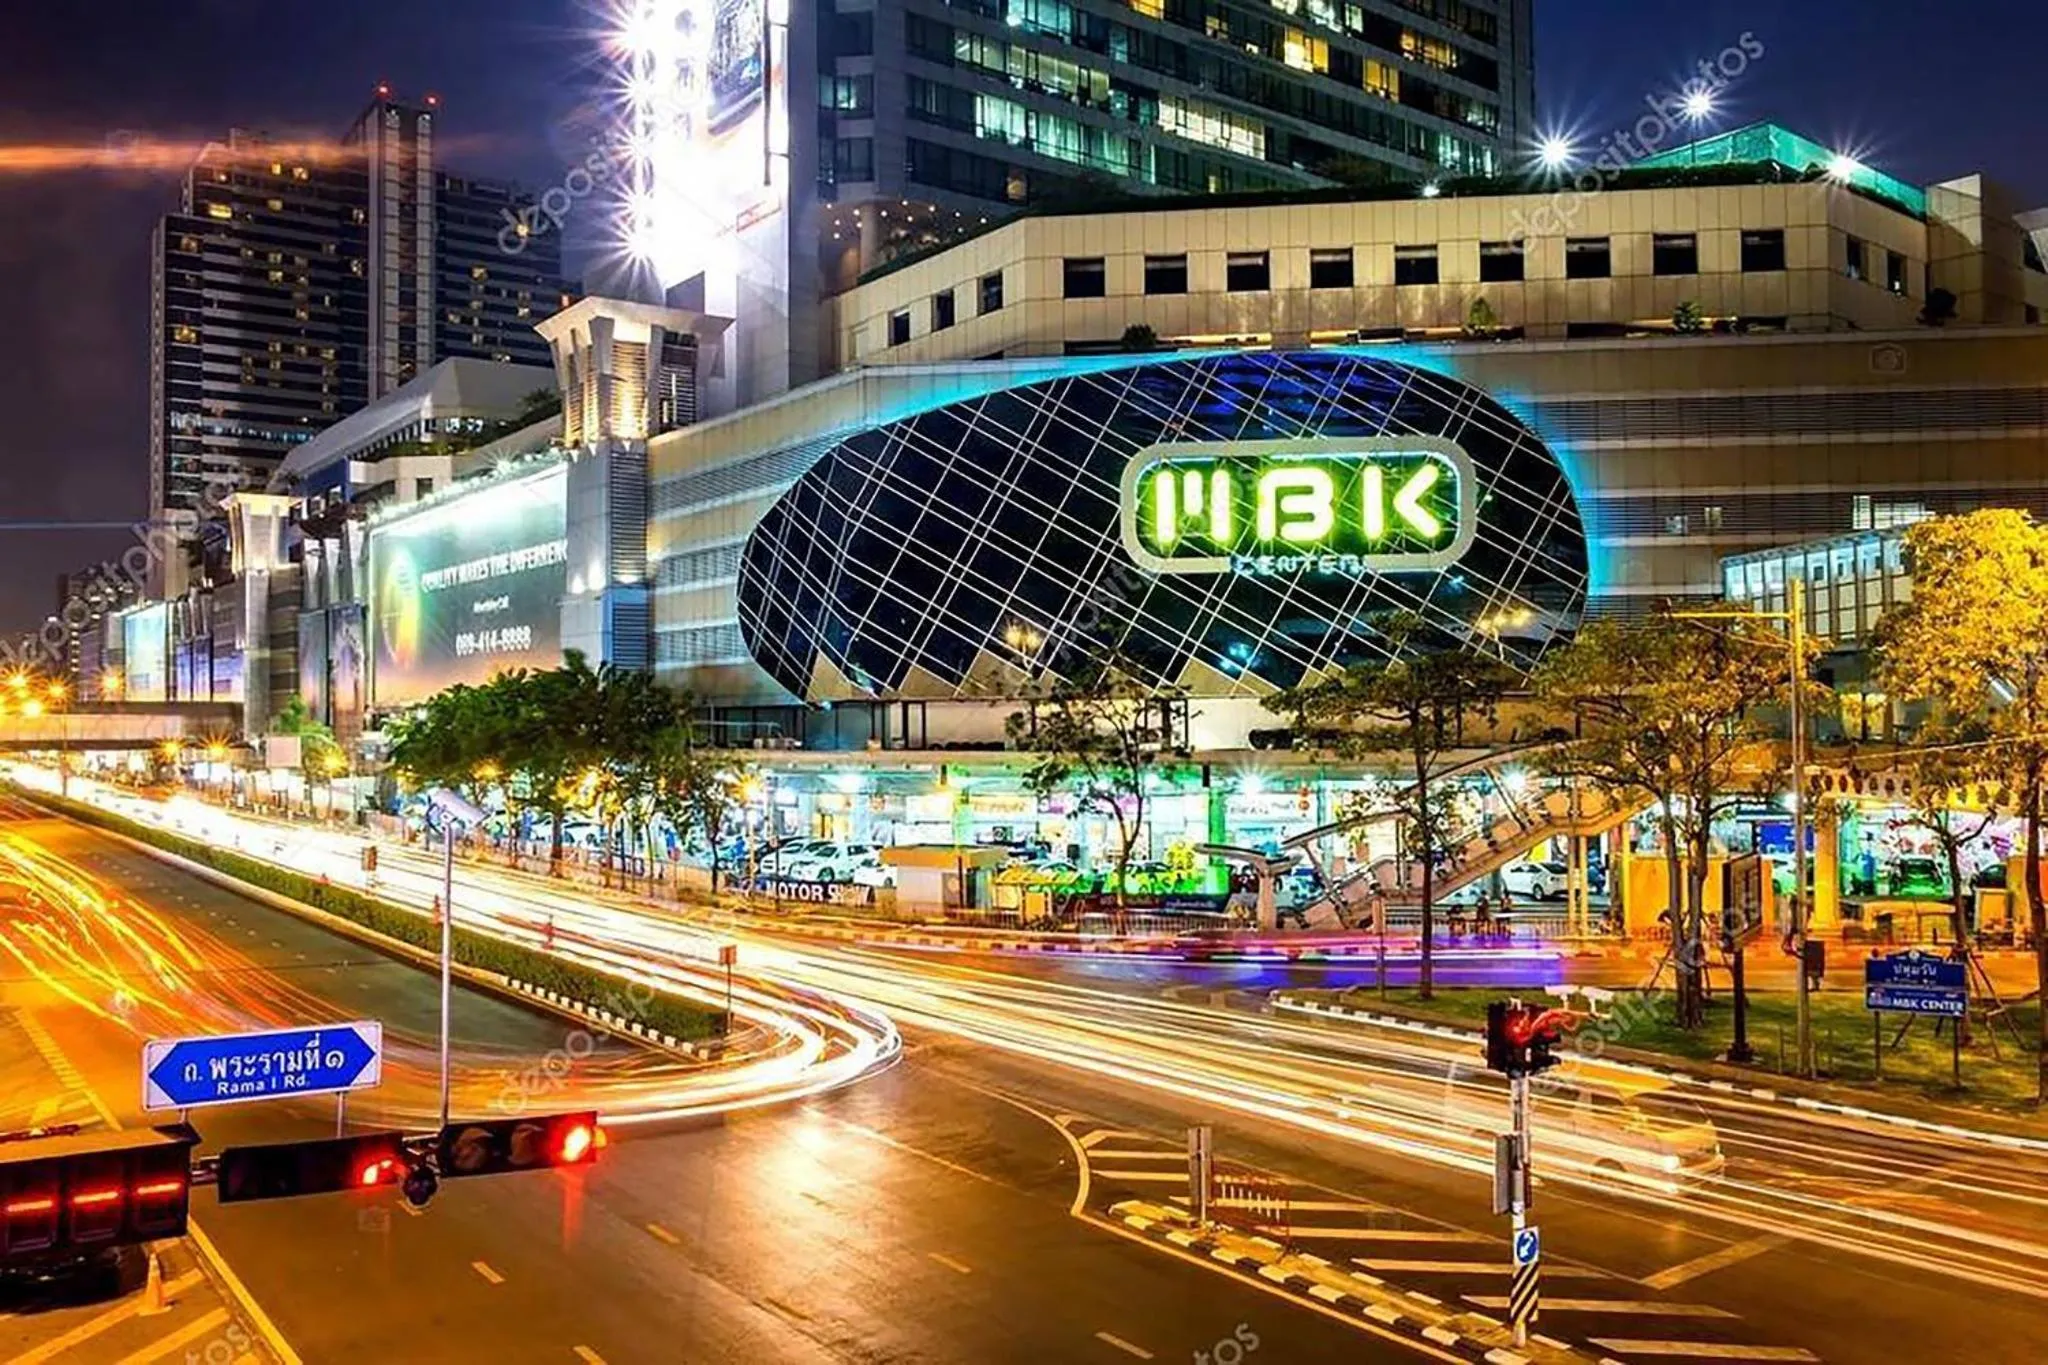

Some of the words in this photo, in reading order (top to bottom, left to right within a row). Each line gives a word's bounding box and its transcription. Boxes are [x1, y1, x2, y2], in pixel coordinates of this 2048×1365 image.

[1155, 466, 1441, 543] MBK
[1231, 554, 1364, 577] CENTER
[766, 880, 824, 902] MOTOR
[1921, 999, 1964, 1010] CENTER
[184, 1063, 203, 1082] ถ.
[210, 1033, 320, 1080] พระรามที่
[217, 1079, 265, 1095] Rama
[285, 1074, 310, 1089] Rd.
